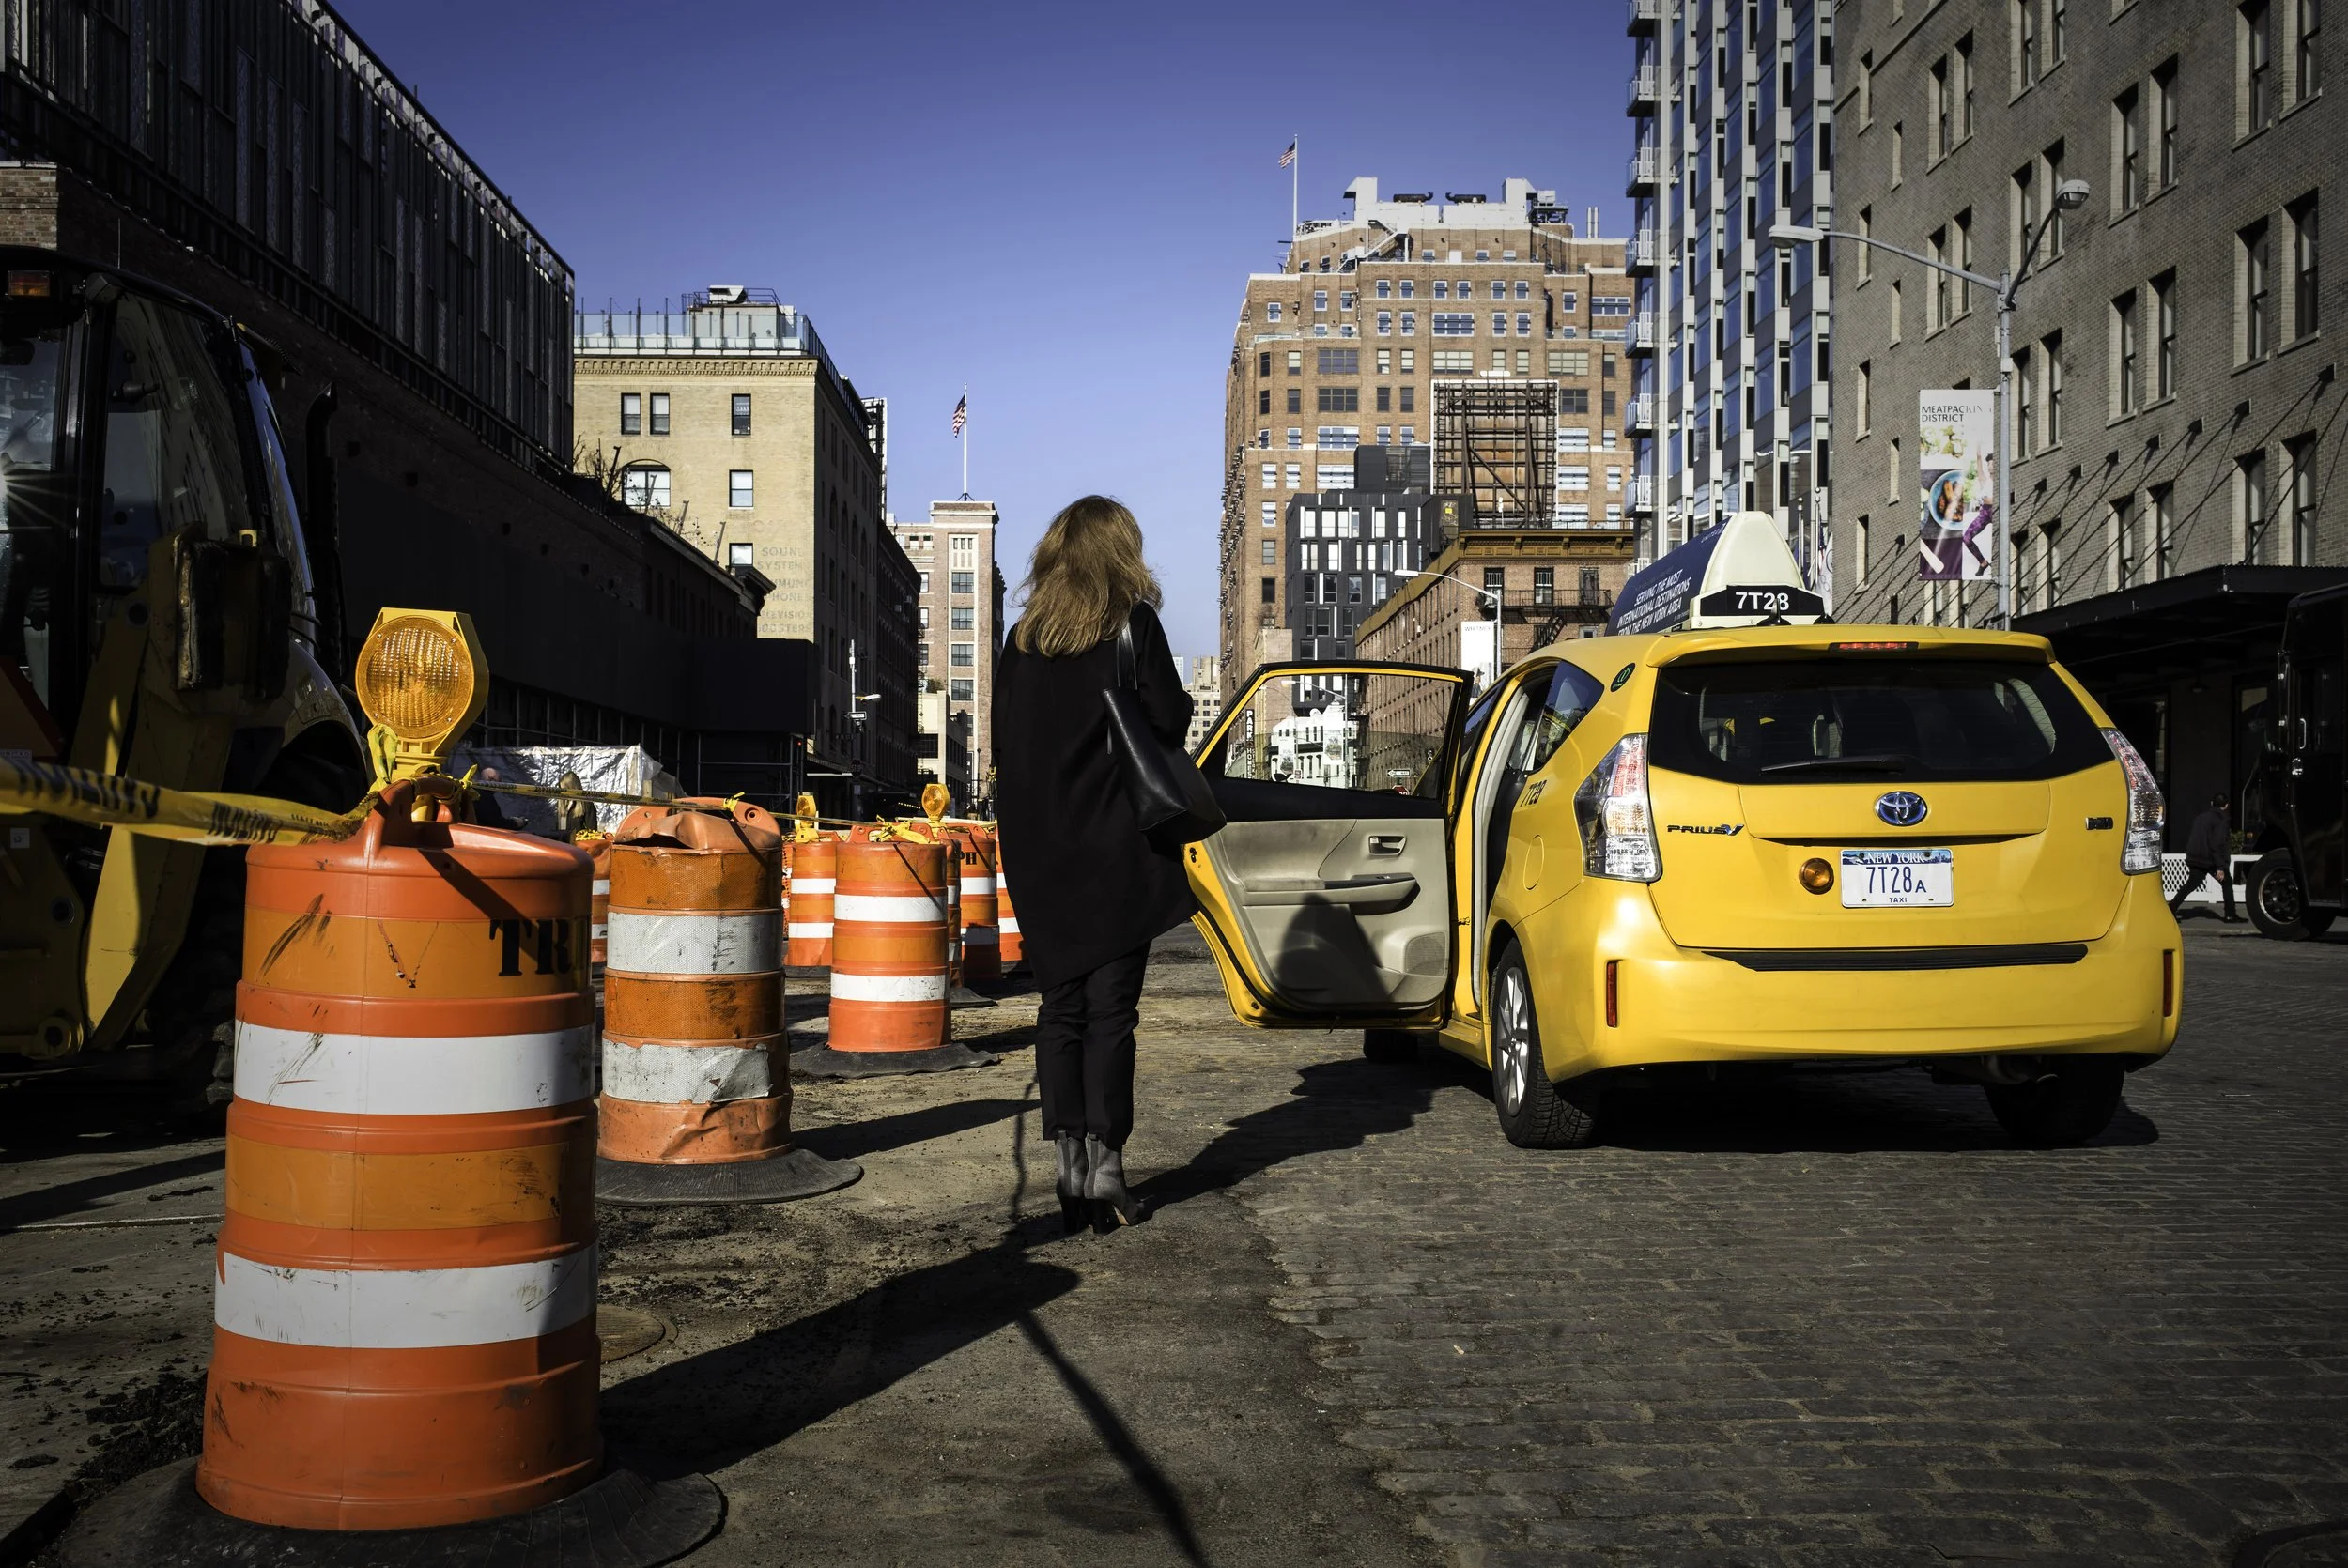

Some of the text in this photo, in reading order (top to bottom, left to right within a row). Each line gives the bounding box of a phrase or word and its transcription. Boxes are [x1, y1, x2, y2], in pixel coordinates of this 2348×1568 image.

[1922, 406, 1992, 414] MEATPACKIN
[1922, 414, 1964, 423] DISTRICT
[1634, 568, 1683, 607] SERVING THE MOST
[1617, 576, 1691, 628] INTERNATIONAL DESTINATIONS
[1736, 592, 1789, 611] 7T28
[1631, 619, 1642, 635] THE
[1641, 612, 1655, 630] NEW
[1653, 604, 1669, 623] YORK
[1666, 596, 1682, 616] AREA
[1520, 780, 1547, 807] 7T28
[1867, 852, 1924, 864] NEW YORK
[1865, 866, 1927, 894] 7T28A
